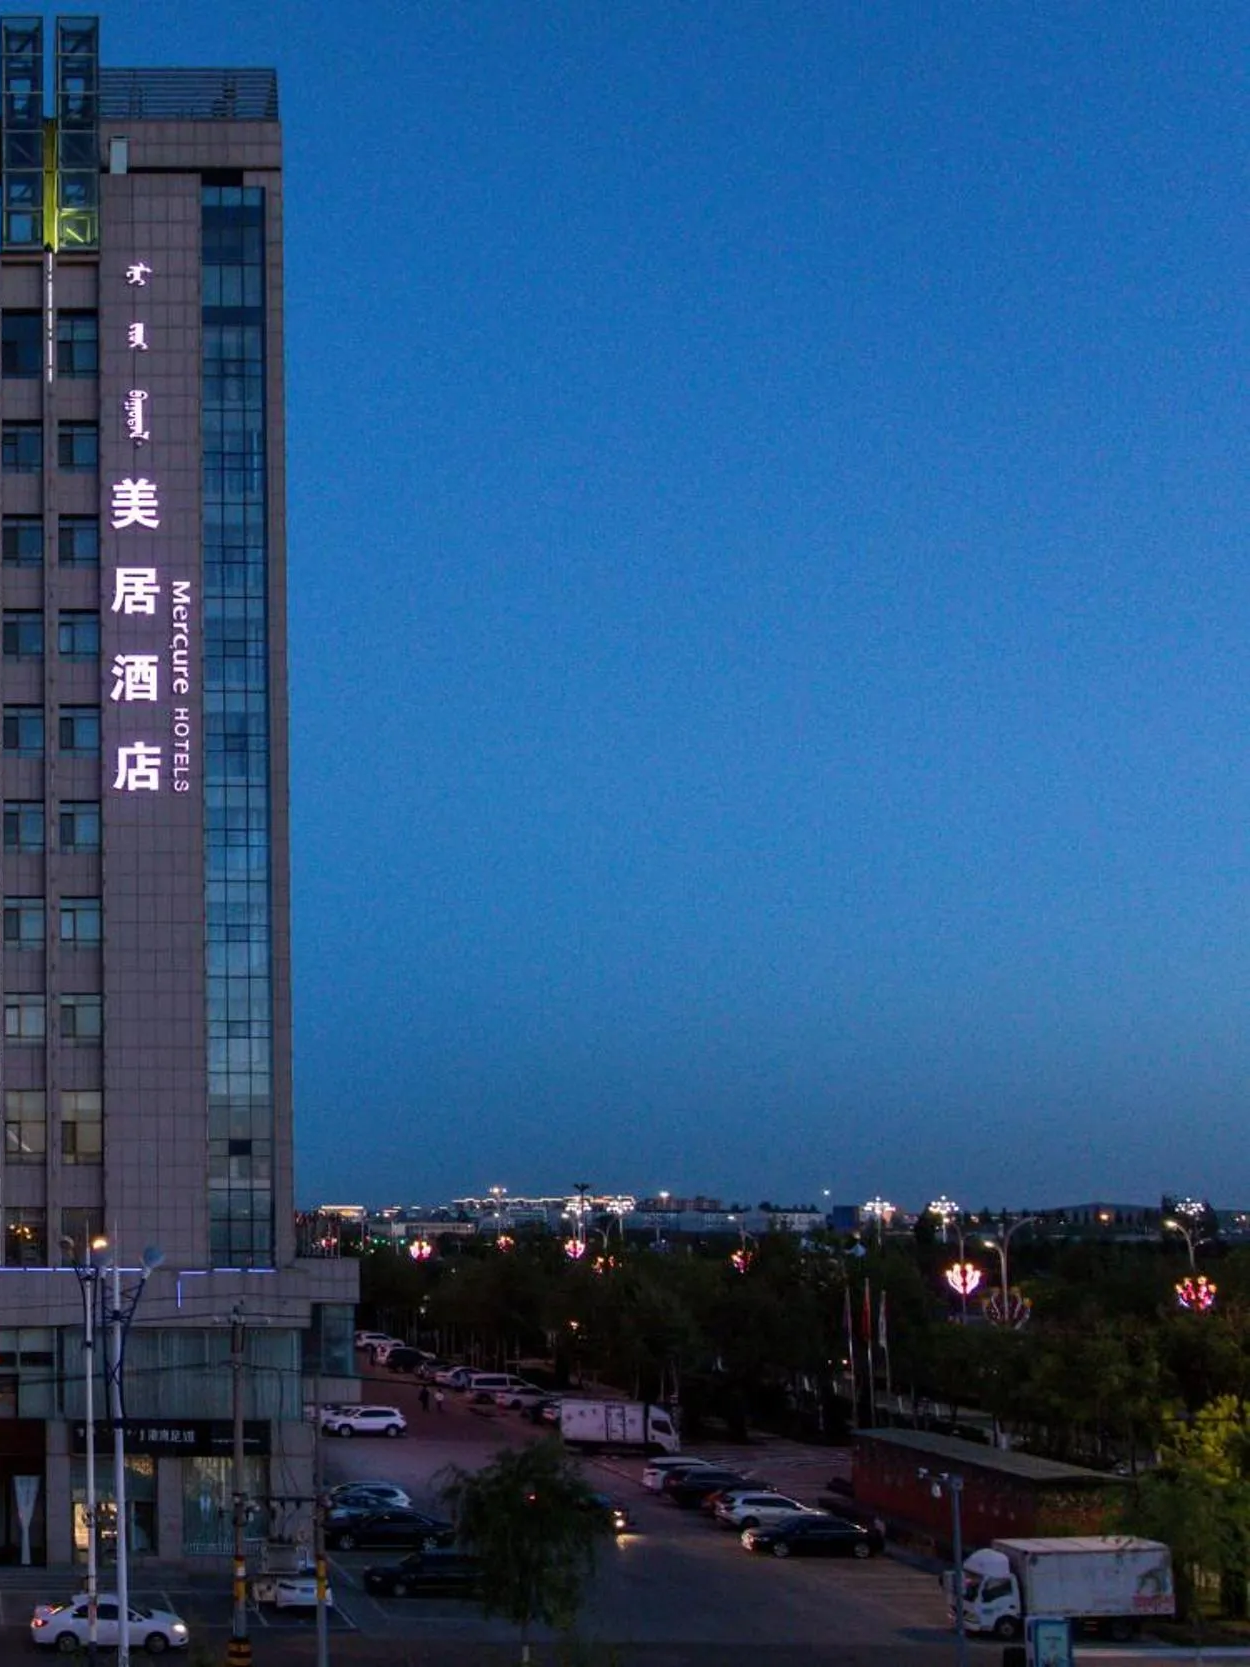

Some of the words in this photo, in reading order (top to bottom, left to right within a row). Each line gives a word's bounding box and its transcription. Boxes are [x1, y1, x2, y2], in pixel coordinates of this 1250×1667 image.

[110, 478, 161, 792] 美居酒店
[169, 581, 191, 694] Mercure
[173, 707, 190, 792] HOTELS
